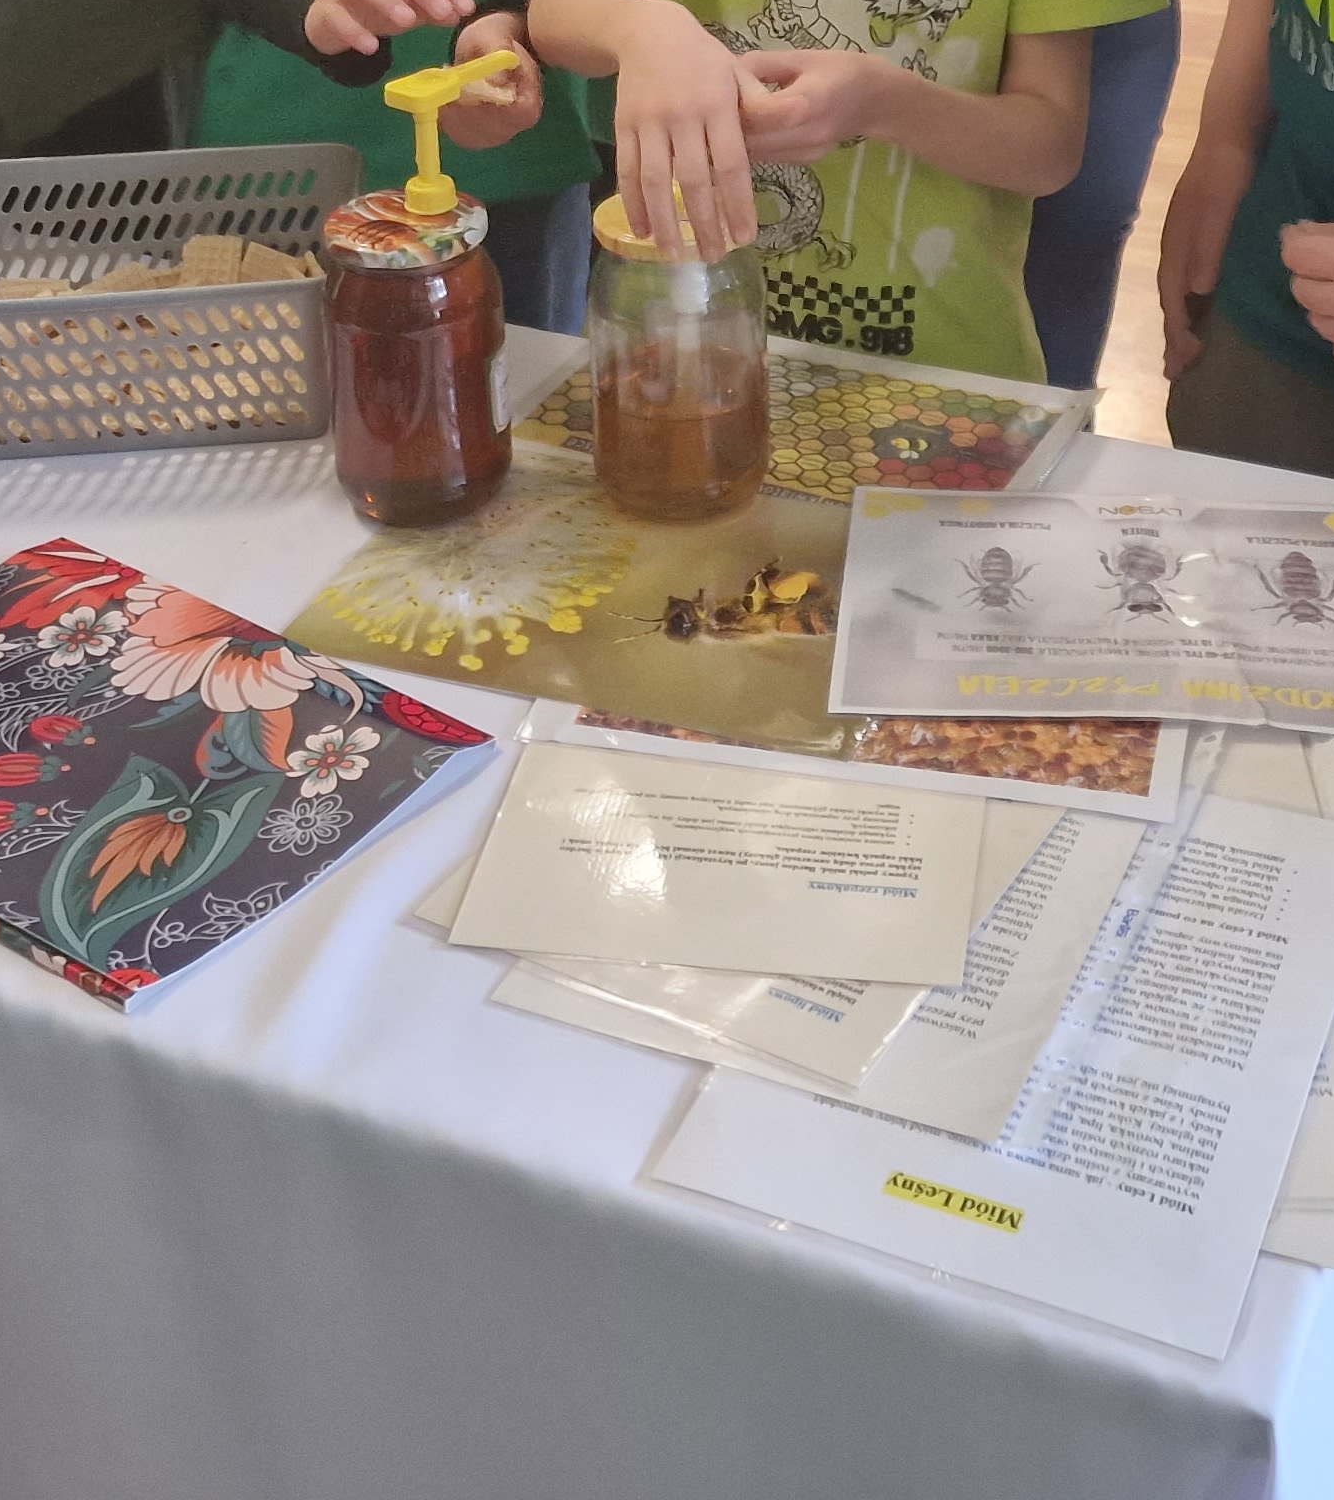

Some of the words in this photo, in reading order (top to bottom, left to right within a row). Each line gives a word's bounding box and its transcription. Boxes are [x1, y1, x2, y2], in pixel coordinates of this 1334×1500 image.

[808, 881, 879, 896] rzepakowy
[883, 888, 917, 900] Miód
[1218, 922, 1254, 937] Leśny
[1256, 931, 1290, 945] Miód
[808, 1002, 845, 1024] Miód
[962, 995, 994, 1011] Miód
[1211, 1054, 1246, 1072] Miód
[1161, 1084, 1233, 1115] bynajmniej
[1107, 1111, 1144, 1130] Kolor
[1128, 1103, 1168, 1124] jakich
[1188, 1120, 1224, 1140] kiedy
[1196, 1136, 1219, 1152] lub
[1161, 1154, 1211, 1176] nektaru
[1083, 1172, 1105, 1188] jak
[1147, 1162, 1207, 1189] iglastych
[885, 1170, 956, 1209] Leśny
[1116, 1182, 1157, 1204] Leśny
[1123, 1170, 1202, 1202] wytwarzany
[959, 1196, 1024, 1230] Miód
[1158, 1195, 1197, 1216] Miód
